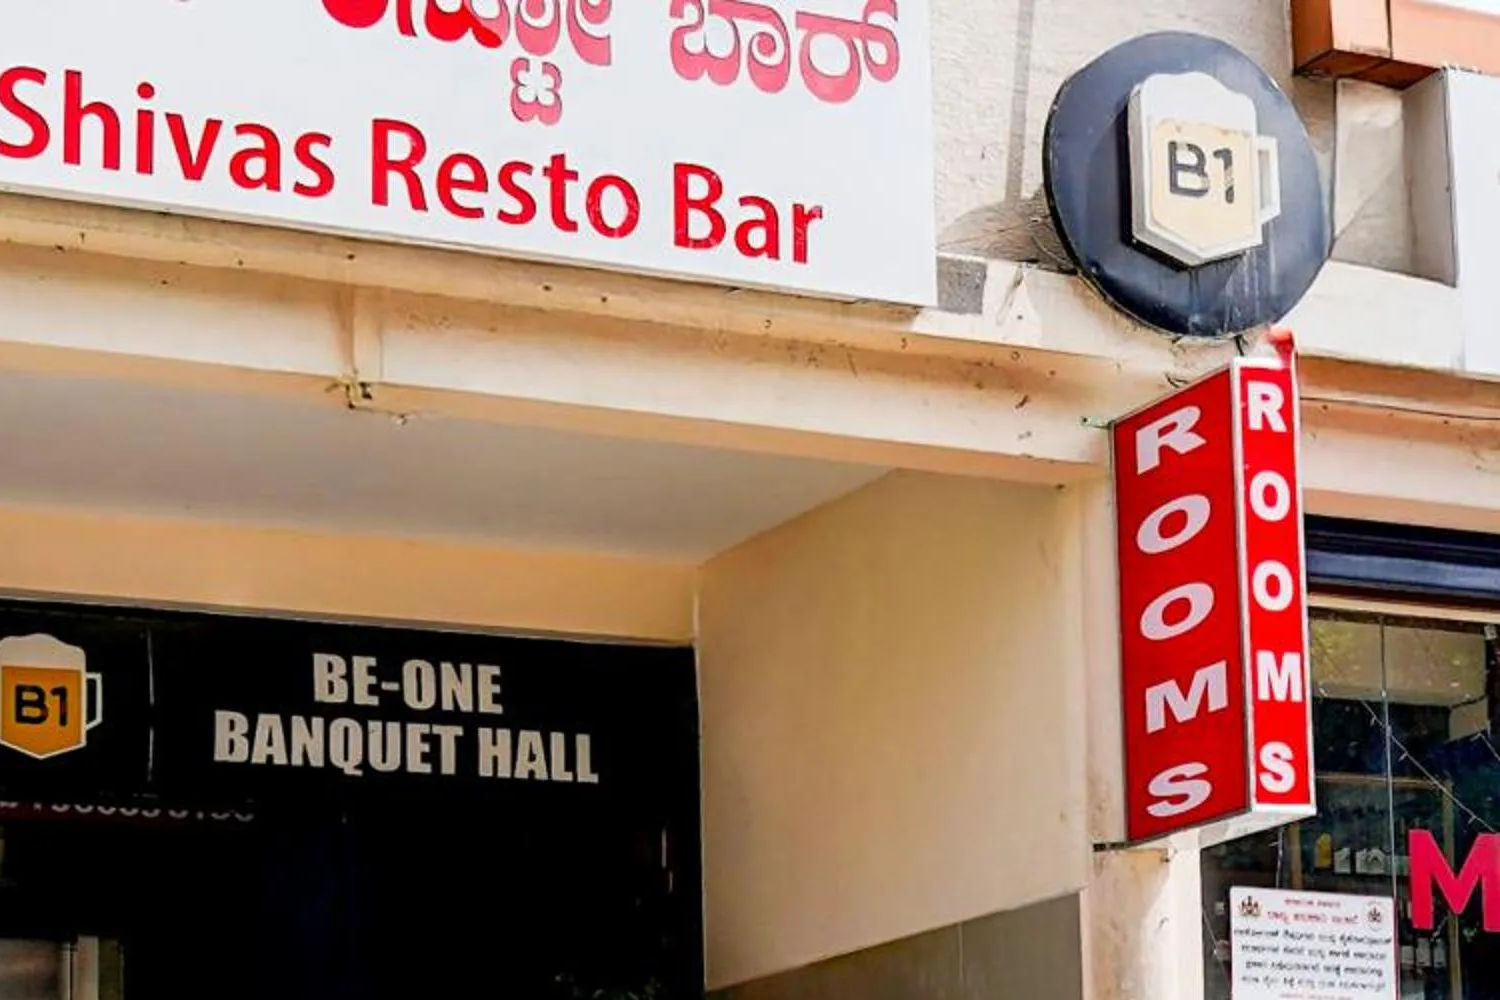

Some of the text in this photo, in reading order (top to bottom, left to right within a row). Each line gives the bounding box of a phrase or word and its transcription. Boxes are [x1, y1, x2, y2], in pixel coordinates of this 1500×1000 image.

[371, 118, 641, 239] Resto
[673, 163, 824, 265] Bar
[1166, 140, 1236, 205] B1
[1135, 405, 1229, 818] ROOMS
[1247, 381, 1303, 794] ROOMS
[14, 683, 68, 728] B1
[312, 652, 504, 715] BE-ONE
[213, 709, 600, 784] BANQUET HALL
